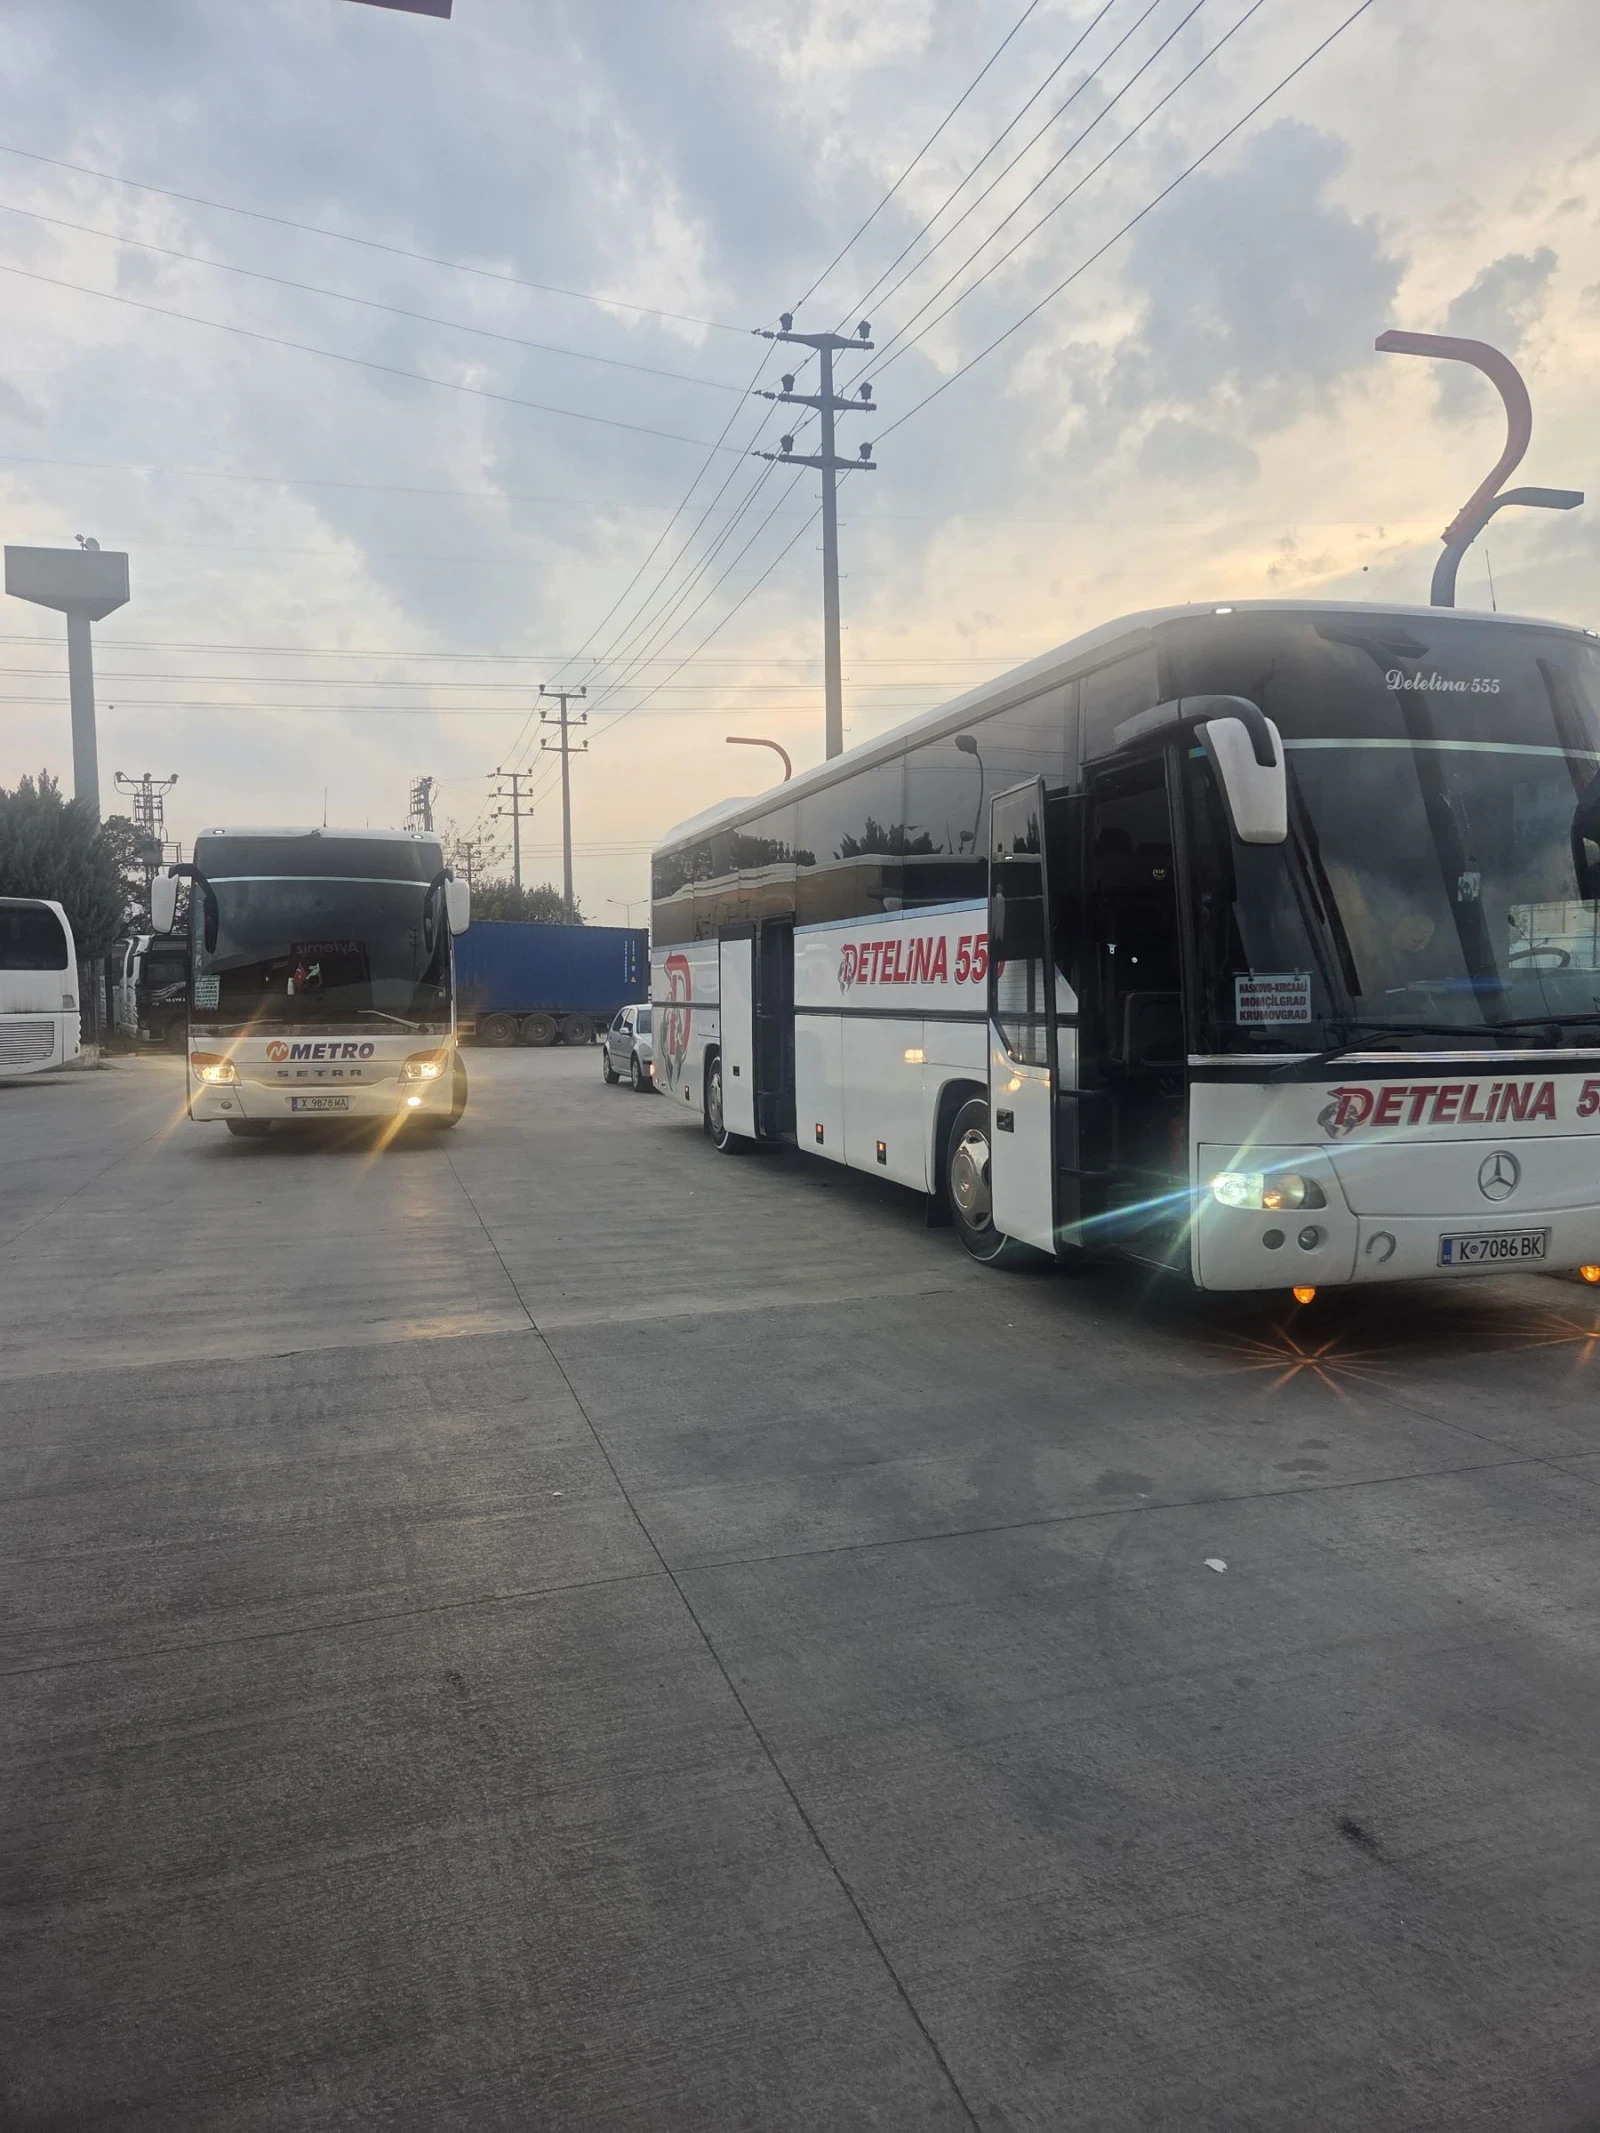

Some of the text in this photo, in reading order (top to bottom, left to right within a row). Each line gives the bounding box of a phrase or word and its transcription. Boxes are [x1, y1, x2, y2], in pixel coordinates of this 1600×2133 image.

[1385, 669, 1501, 693] Detelina 555
[1239, 1010, 1308, 1021] KRUMOVGRAD
[290, 1042, 375, 1060] METRO
[277, 1069, 362, 1077] SETRA
[301, 1099, 307, 1108] X
[311, 1099, 333, 1108] 9878
[1576, 1079, 1600, 1118] 5
[1460, 1241, 1470, 1260] K
[1479, 1239, 1518, 1259] 7086
[1521, 1236, 1542, 1256] BK
